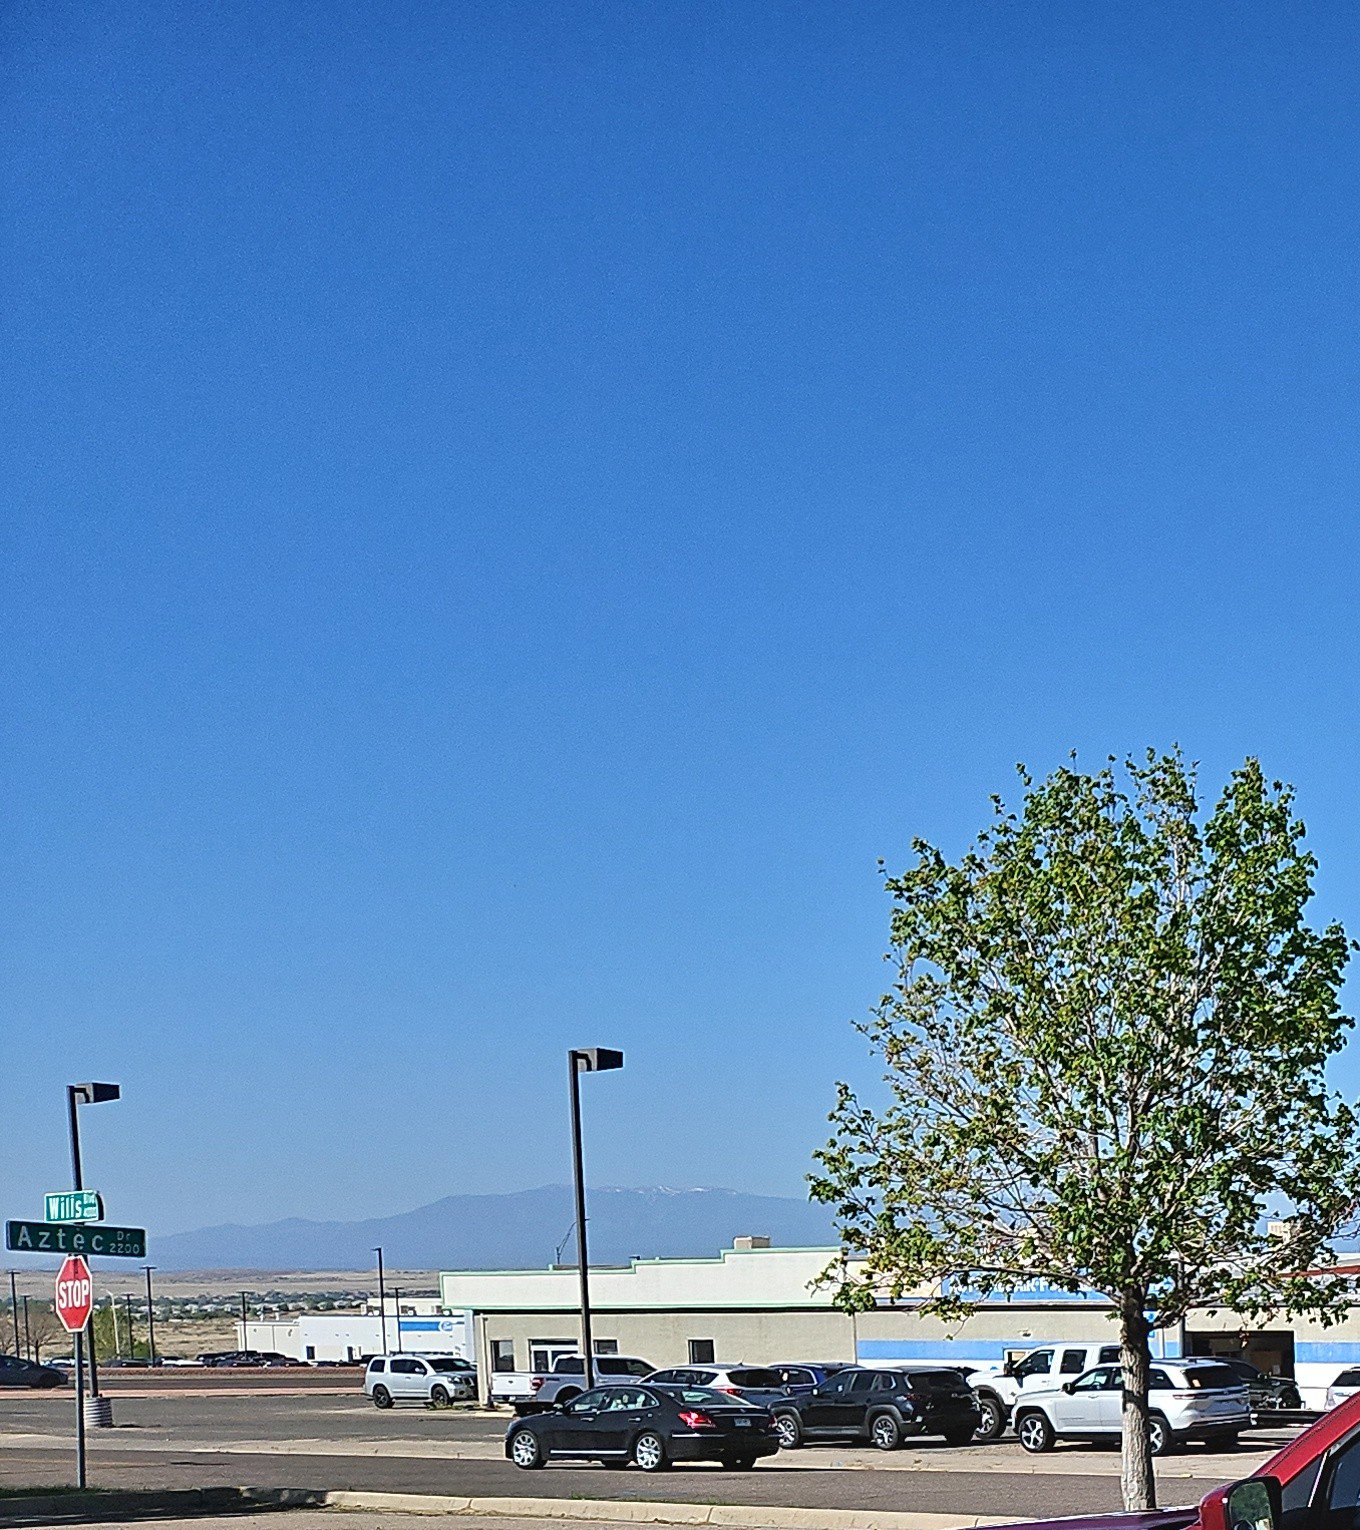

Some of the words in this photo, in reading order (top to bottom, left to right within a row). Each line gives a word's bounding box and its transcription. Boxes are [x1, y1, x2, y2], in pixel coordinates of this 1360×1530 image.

[17, 1225, 104, 1251] Aztec
[116, 1231, 131, 1241] Dr
[109, 1243, 140, 1254] 2200
[58, 1279, 90, 1309] STOP
